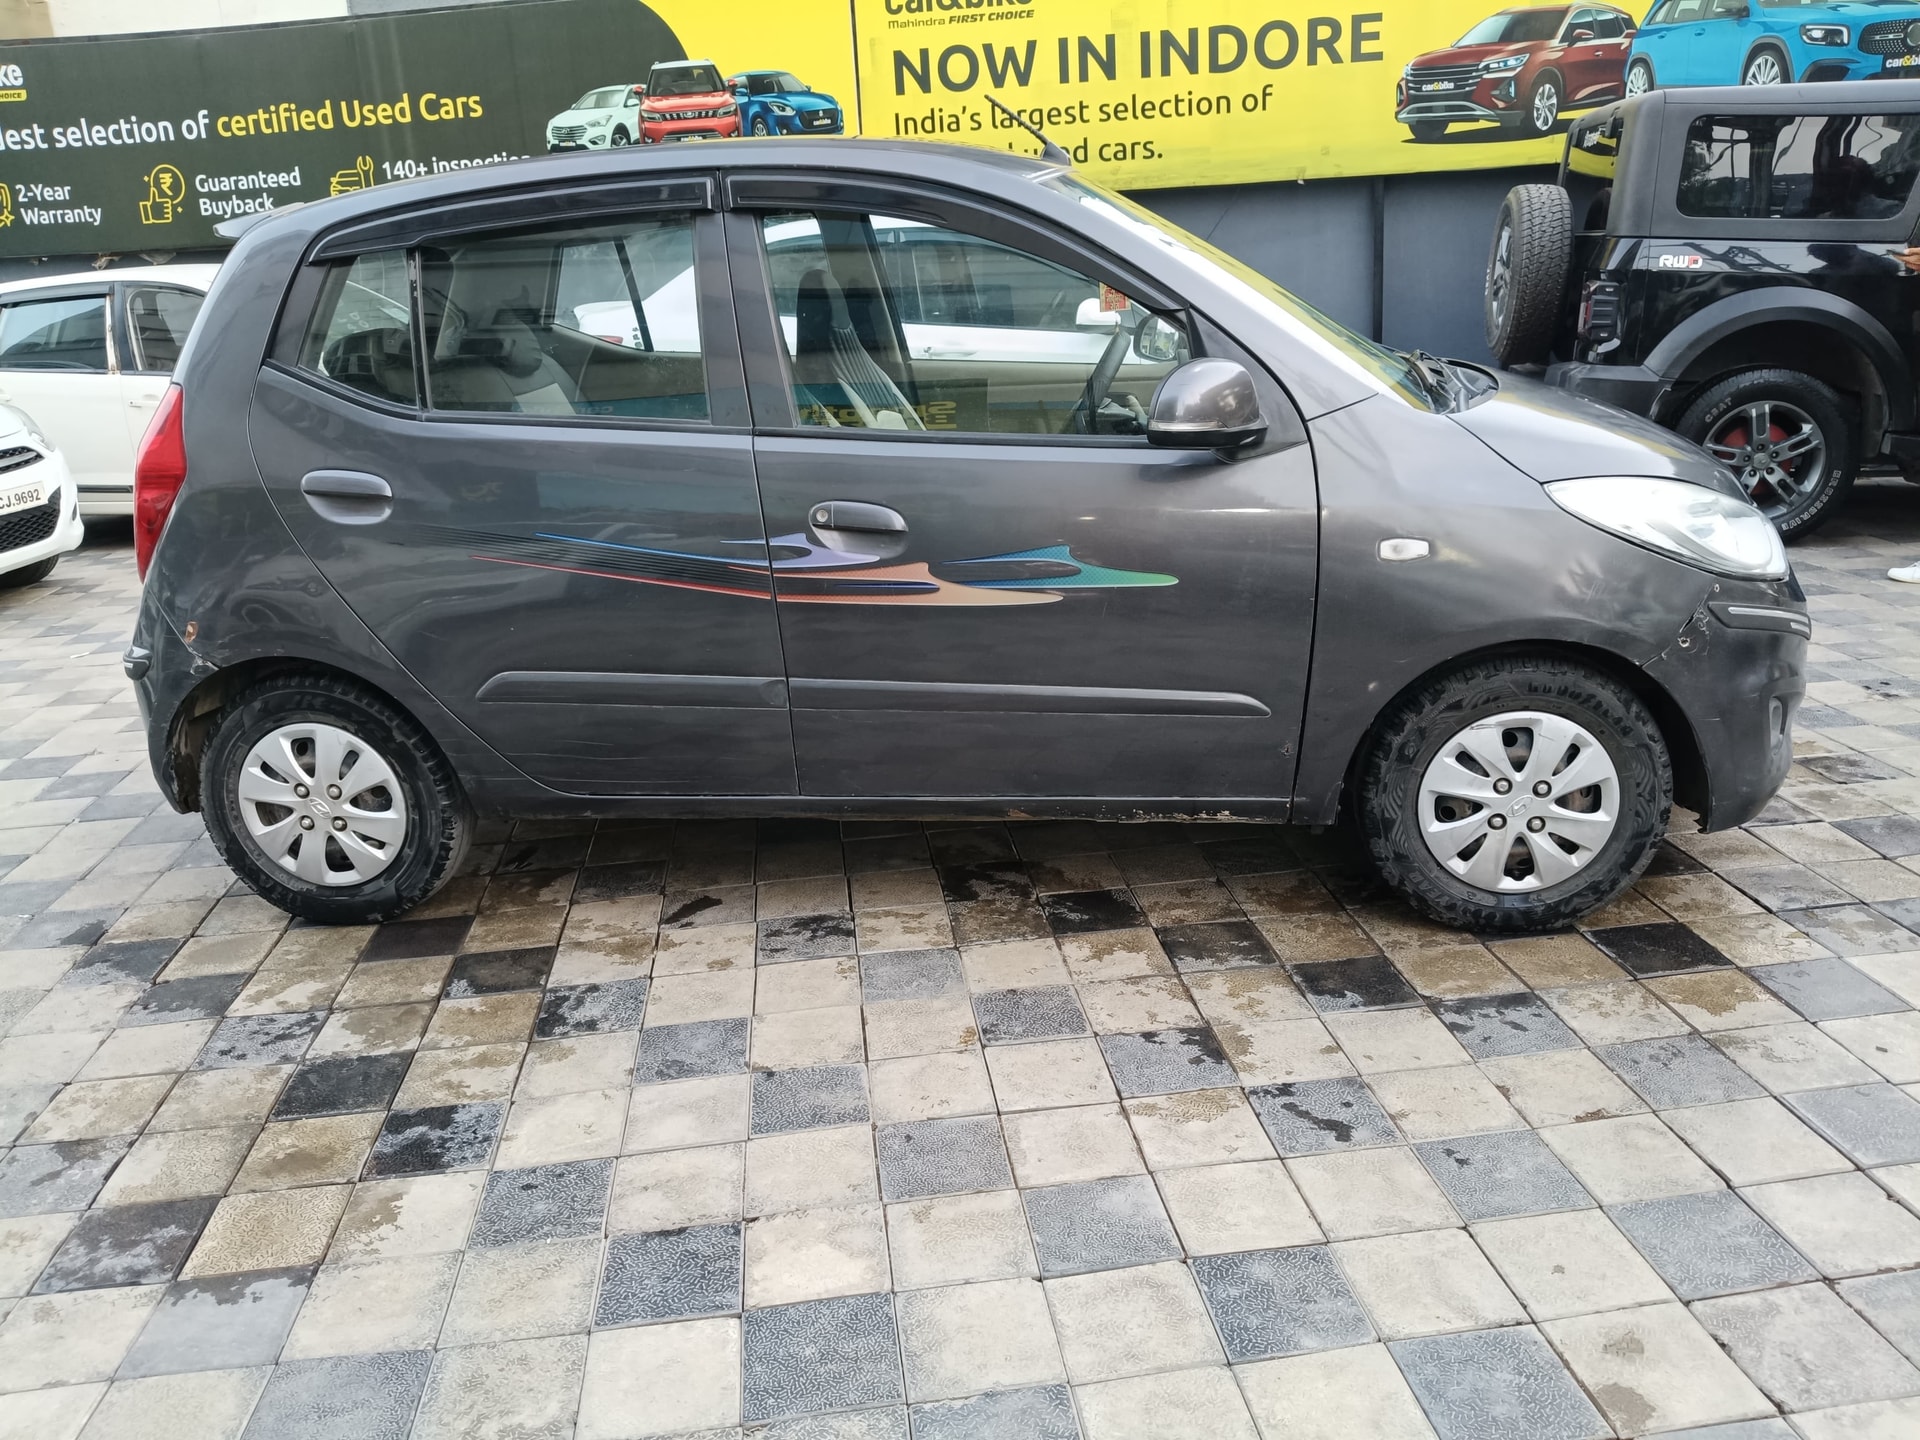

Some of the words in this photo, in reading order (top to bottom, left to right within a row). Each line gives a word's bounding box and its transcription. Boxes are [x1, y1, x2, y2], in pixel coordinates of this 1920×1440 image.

[888, 18, 945, 29] Mahindra
[948, 13, 986, 25] FIRST
[987, 9, 1035, 21] CHOICE
[892, 39, 1038, 96] NOW
[1057, 34, 1117, 85] IN
[1139, 12, 1385, 79] INDORE
[991, 101, 1090, 132] largest
[1098, 91, 1231, 122] selection
[1241, 84, 1274, 112] of
[52, 116, 175, 148] selection
[181, 109, 210, 140] of
[216, 100, 334, 137] certified
[340, 93, 412, 128] Used
[419, 93, 483, 121] Cars
[1098, 140, 1164, 162] cars.
[195, 166, 301, 192] Guaranteed
[382, 159, 428, 180] 140+
[15, 184, 72, 202] 2-Year
[20, 205, 102, 226] Warranty
[199, 193, 275, 218] Buyback
[1659, 254, 1703, 269] RWD
